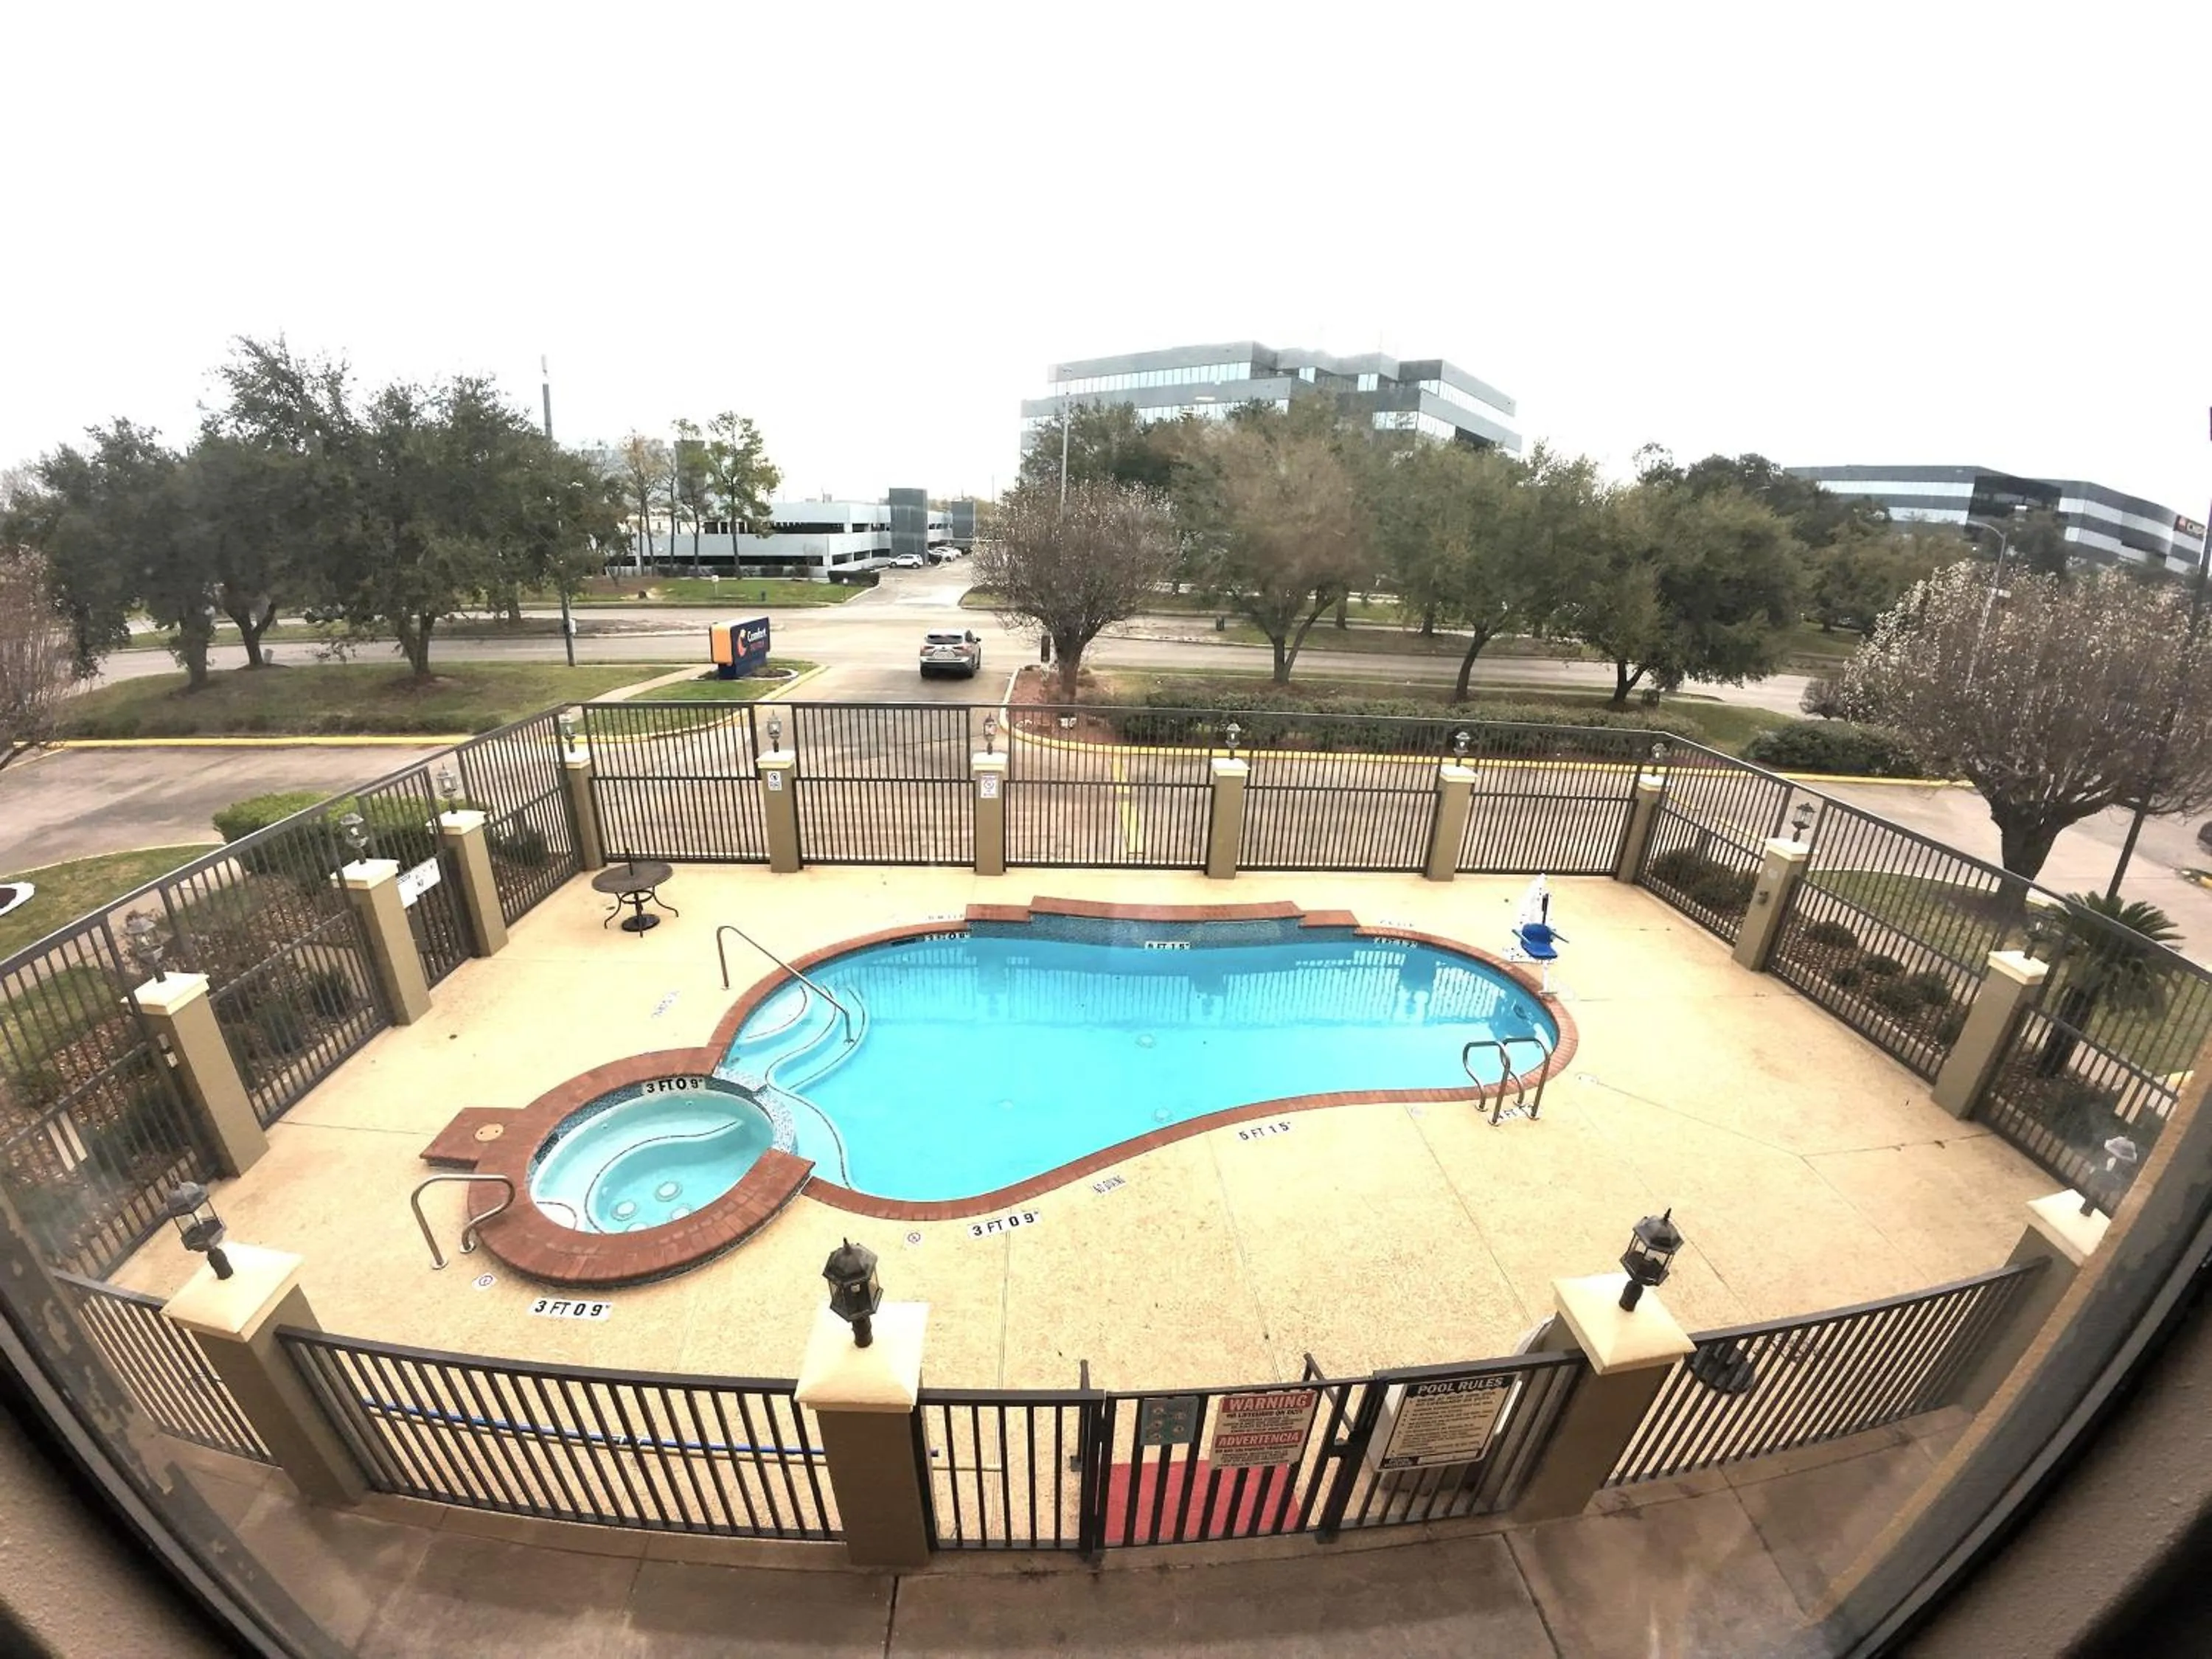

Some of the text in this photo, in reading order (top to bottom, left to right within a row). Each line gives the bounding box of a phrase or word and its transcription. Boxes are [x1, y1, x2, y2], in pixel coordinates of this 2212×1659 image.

[646, 1083, 655, 1093] 3
[1251, 1127, 1265, 1138] FT
[973, 1225, 983, 1236] 3
[535, 1300, 547, 1313] 3
[1418, 1377, 1504, 1394] POOL RULES
[1229, 1394, 1308, 1411] WARNING
[1218, 1433, 1298, 1447] ADVERTENCIA
